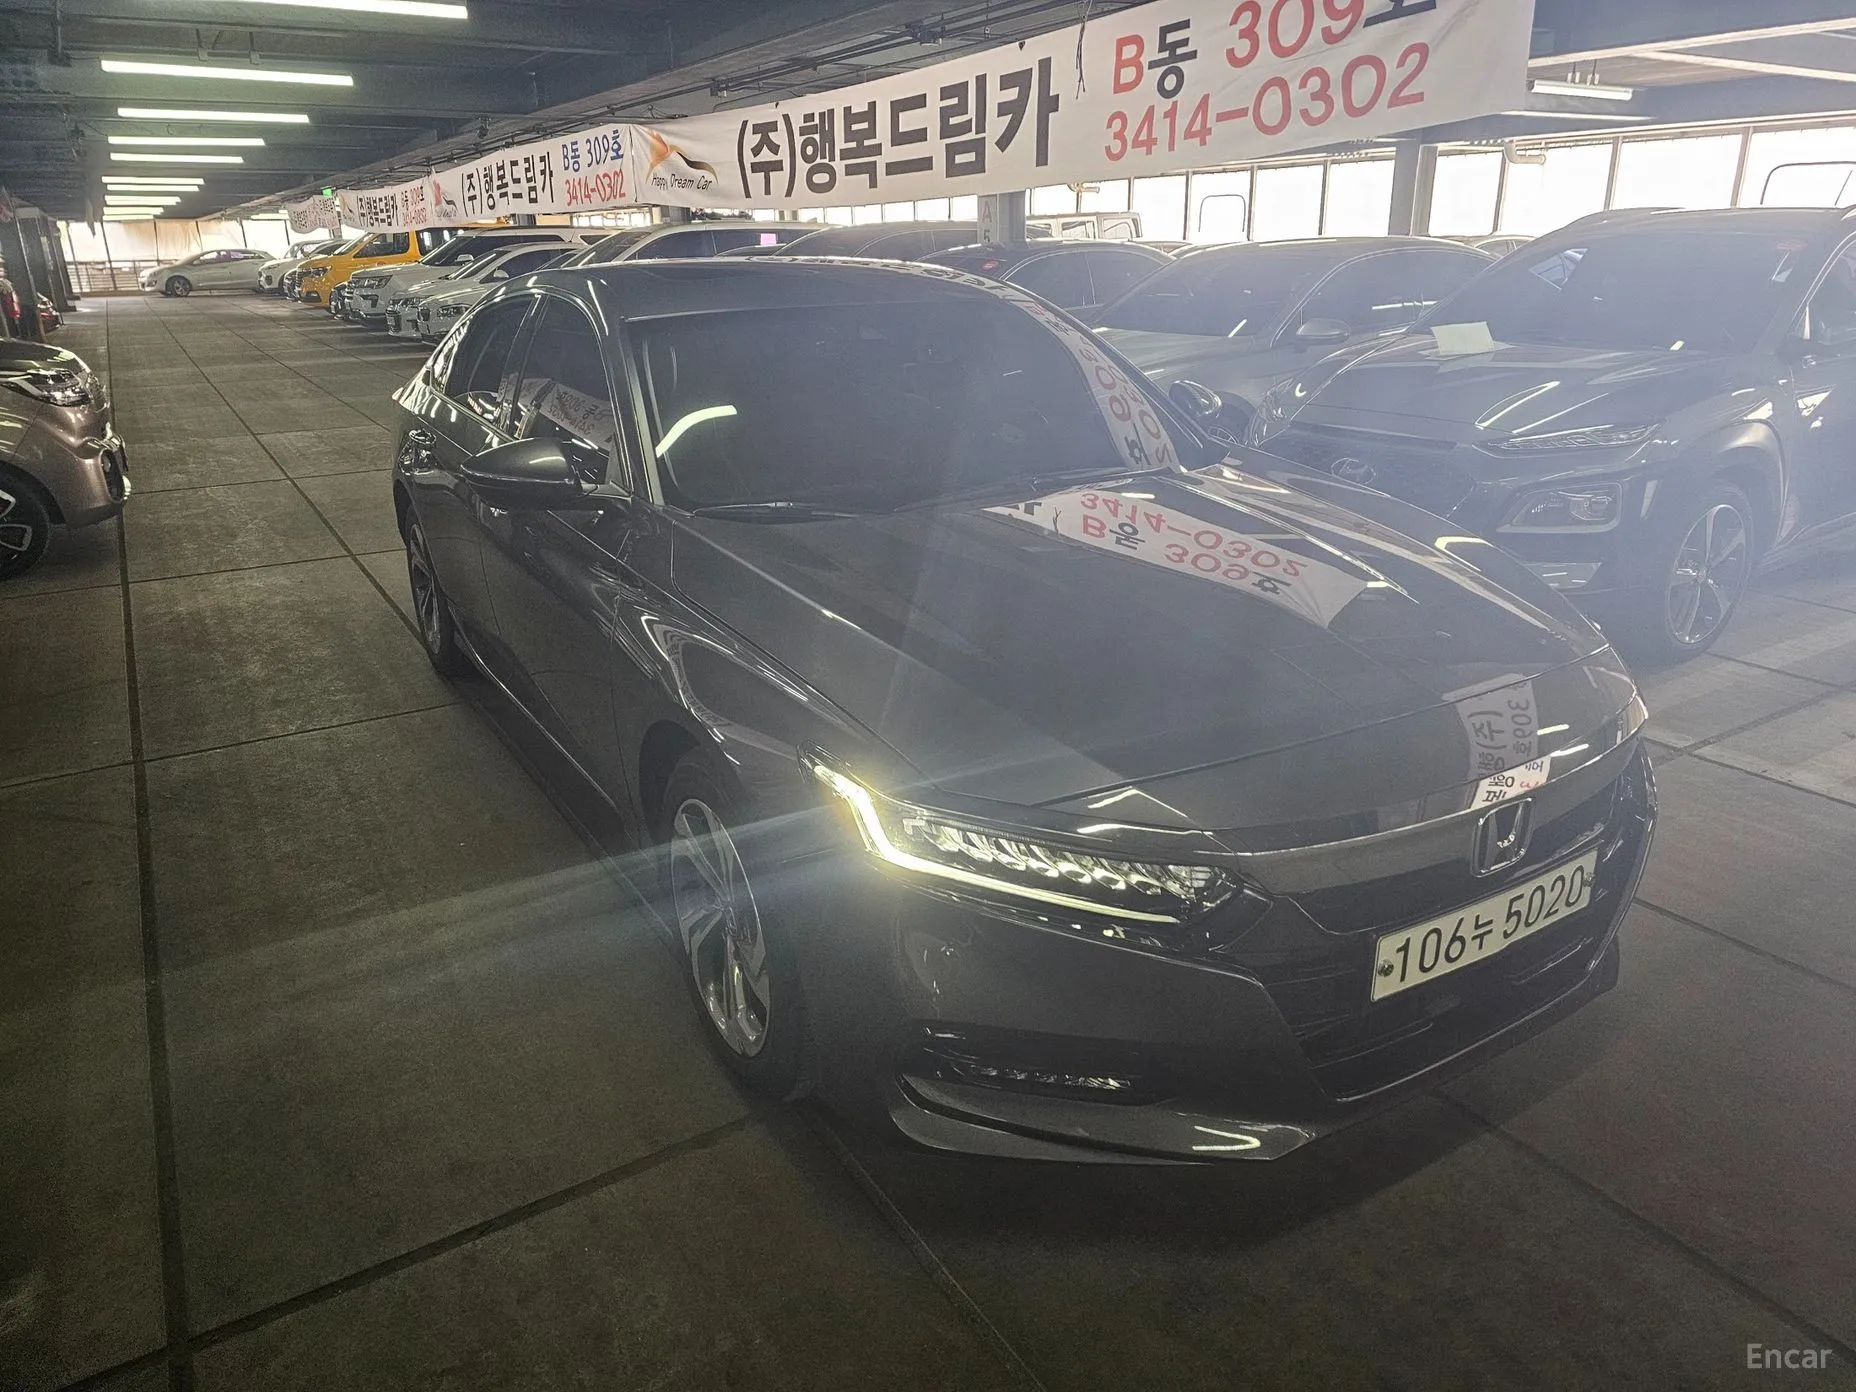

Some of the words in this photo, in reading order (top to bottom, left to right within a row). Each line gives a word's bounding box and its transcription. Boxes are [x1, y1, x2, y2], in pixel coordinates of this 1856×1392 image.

[1112, 19, 1198, 100] B동
[1226, 0, 1437, 69] 309
[737, 56, 1060, 199] (주)행복드림카
[1104, 42, 1430, 162] 3414-0302
[461, 151, 554, 218] (주)행복드림카
[562, 140, 581, 173] B동
[585, 129, 625, 168] 309호
[670, 173, 694, 189] Dream
[697, 175, 712, 190] Car
[564, 168, 626, 207] 3414-0302
